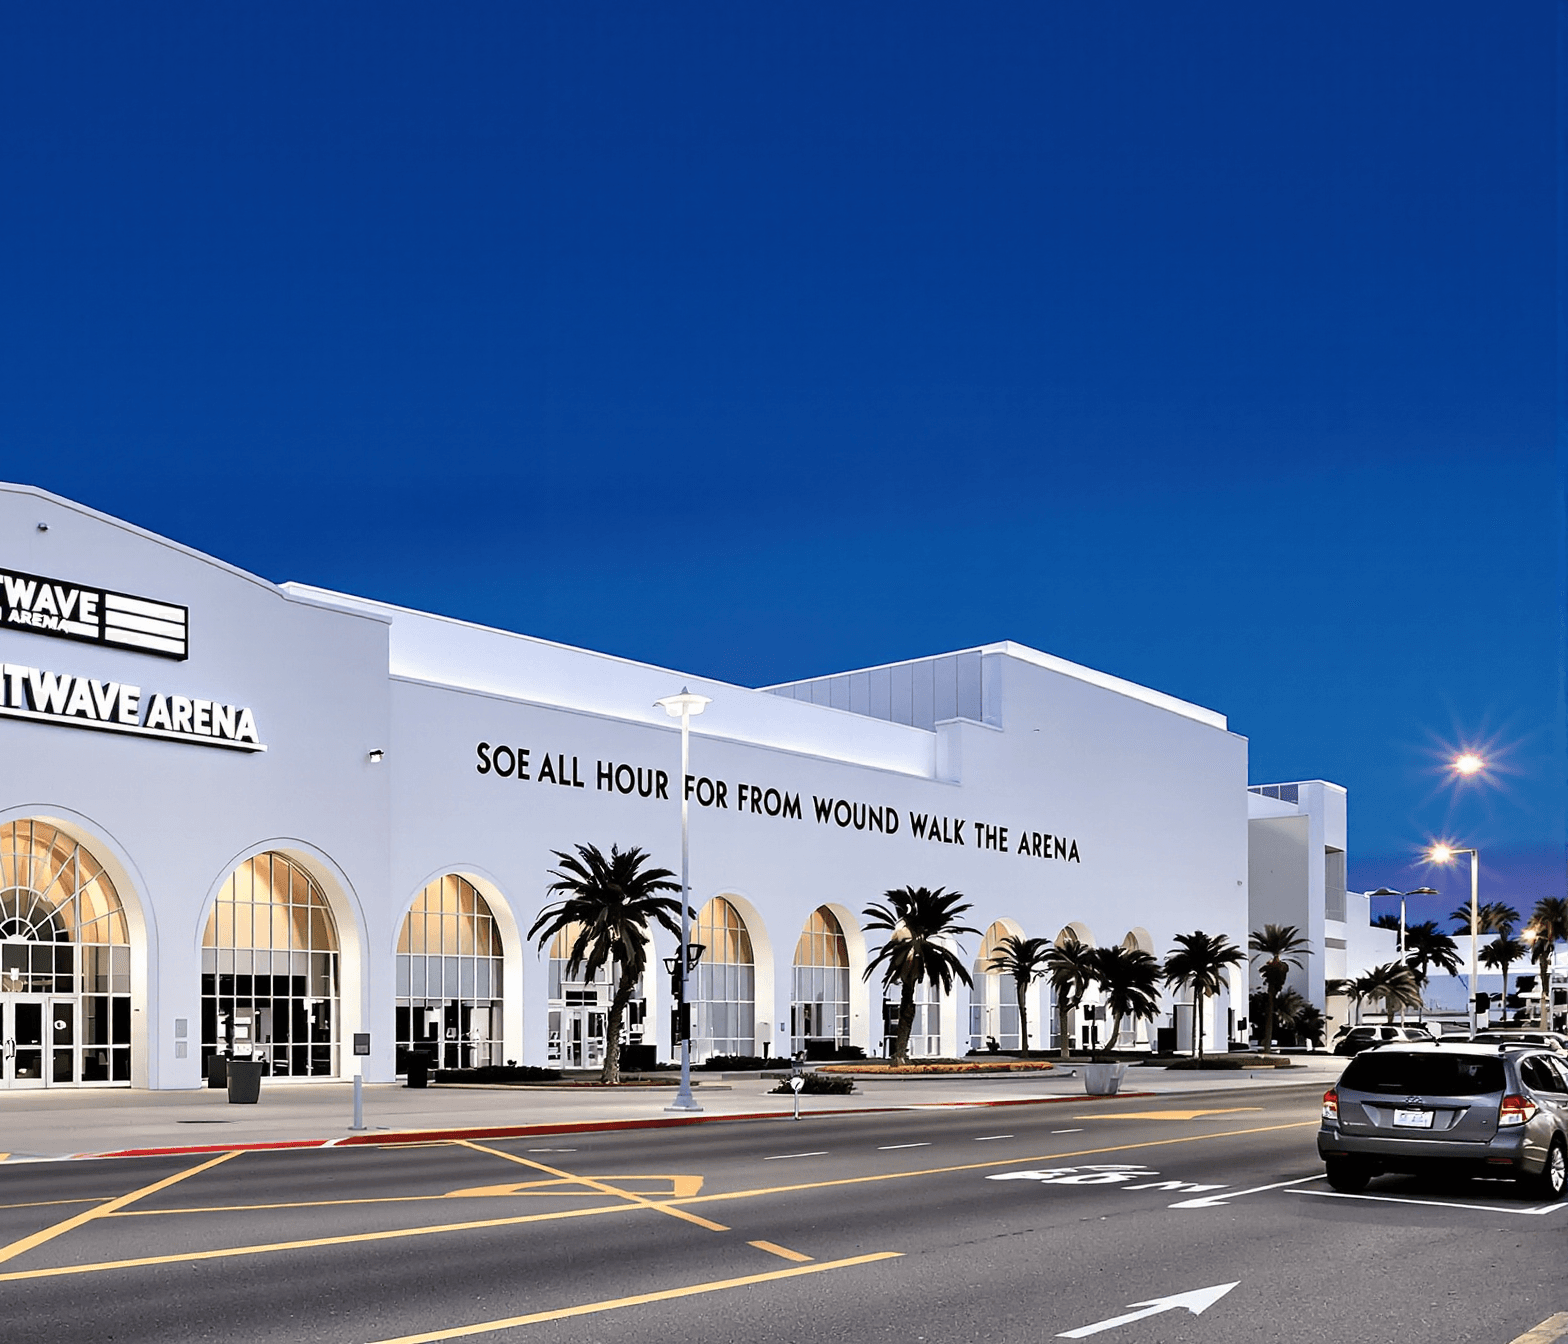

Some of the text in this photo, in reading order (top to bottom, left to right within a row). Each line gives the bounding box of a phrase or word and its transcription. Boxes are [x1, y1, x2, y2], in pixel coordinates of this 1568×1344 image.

[146, 693, 261, 744] ARENA
[476, 741, 1081, 864] SOE ALL HOUR FOR FROM WOUND WALK THE ARENA
